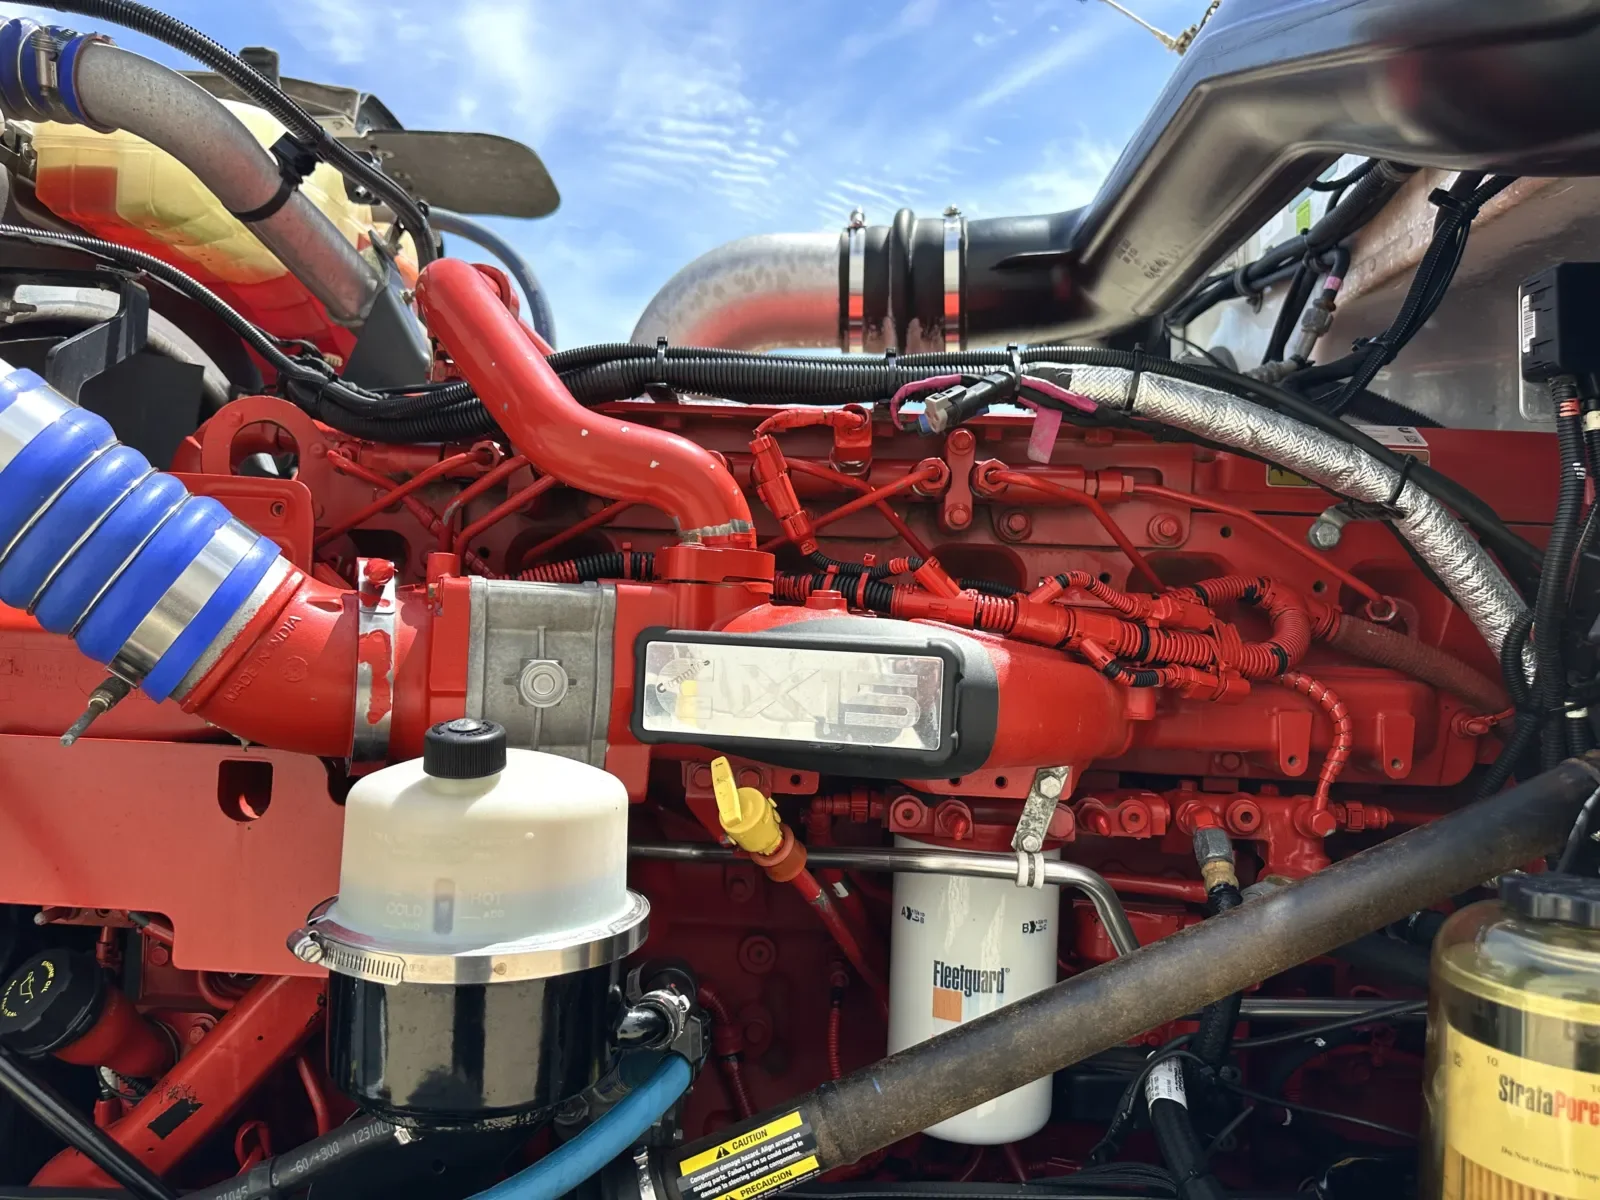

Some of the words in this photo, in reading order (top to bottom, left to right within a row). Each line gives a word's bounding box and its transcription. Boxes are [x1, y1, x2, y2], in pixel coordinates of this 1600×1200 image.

[267, 614, 302, 649] INDIA
[386, 901, 423, 918] COLD
[40, 980, 52, 994] OIL
[731, 1128, 768, 1150] CAUTION
[290, 1141, 340, 1173] -60/+300
[689, 1166, 720, 1185] Component
[719, 1157, 742, 1172] damage
[740, 1148, 761, 1162] hazard.
[760, 1142, 775, 1154] Align
[774, 1135, 793, 1147] arrows
[692, 1180, 713, 1193] mating
[711, 1173, 728, 1185] parts.
[727, 1164, 747, 1178] Failure
[766, 1149, 782, 1160] could
[781, 1142, 798, 1153] result
[700, 1184, 723, 1199] damage
[728, 1172, 750, 1187] steering
[749, 1163, 770, 1177] system
[768, 1149, 802, 1169] components.
[740, 1169, 793, 1198] PRECAUCION
